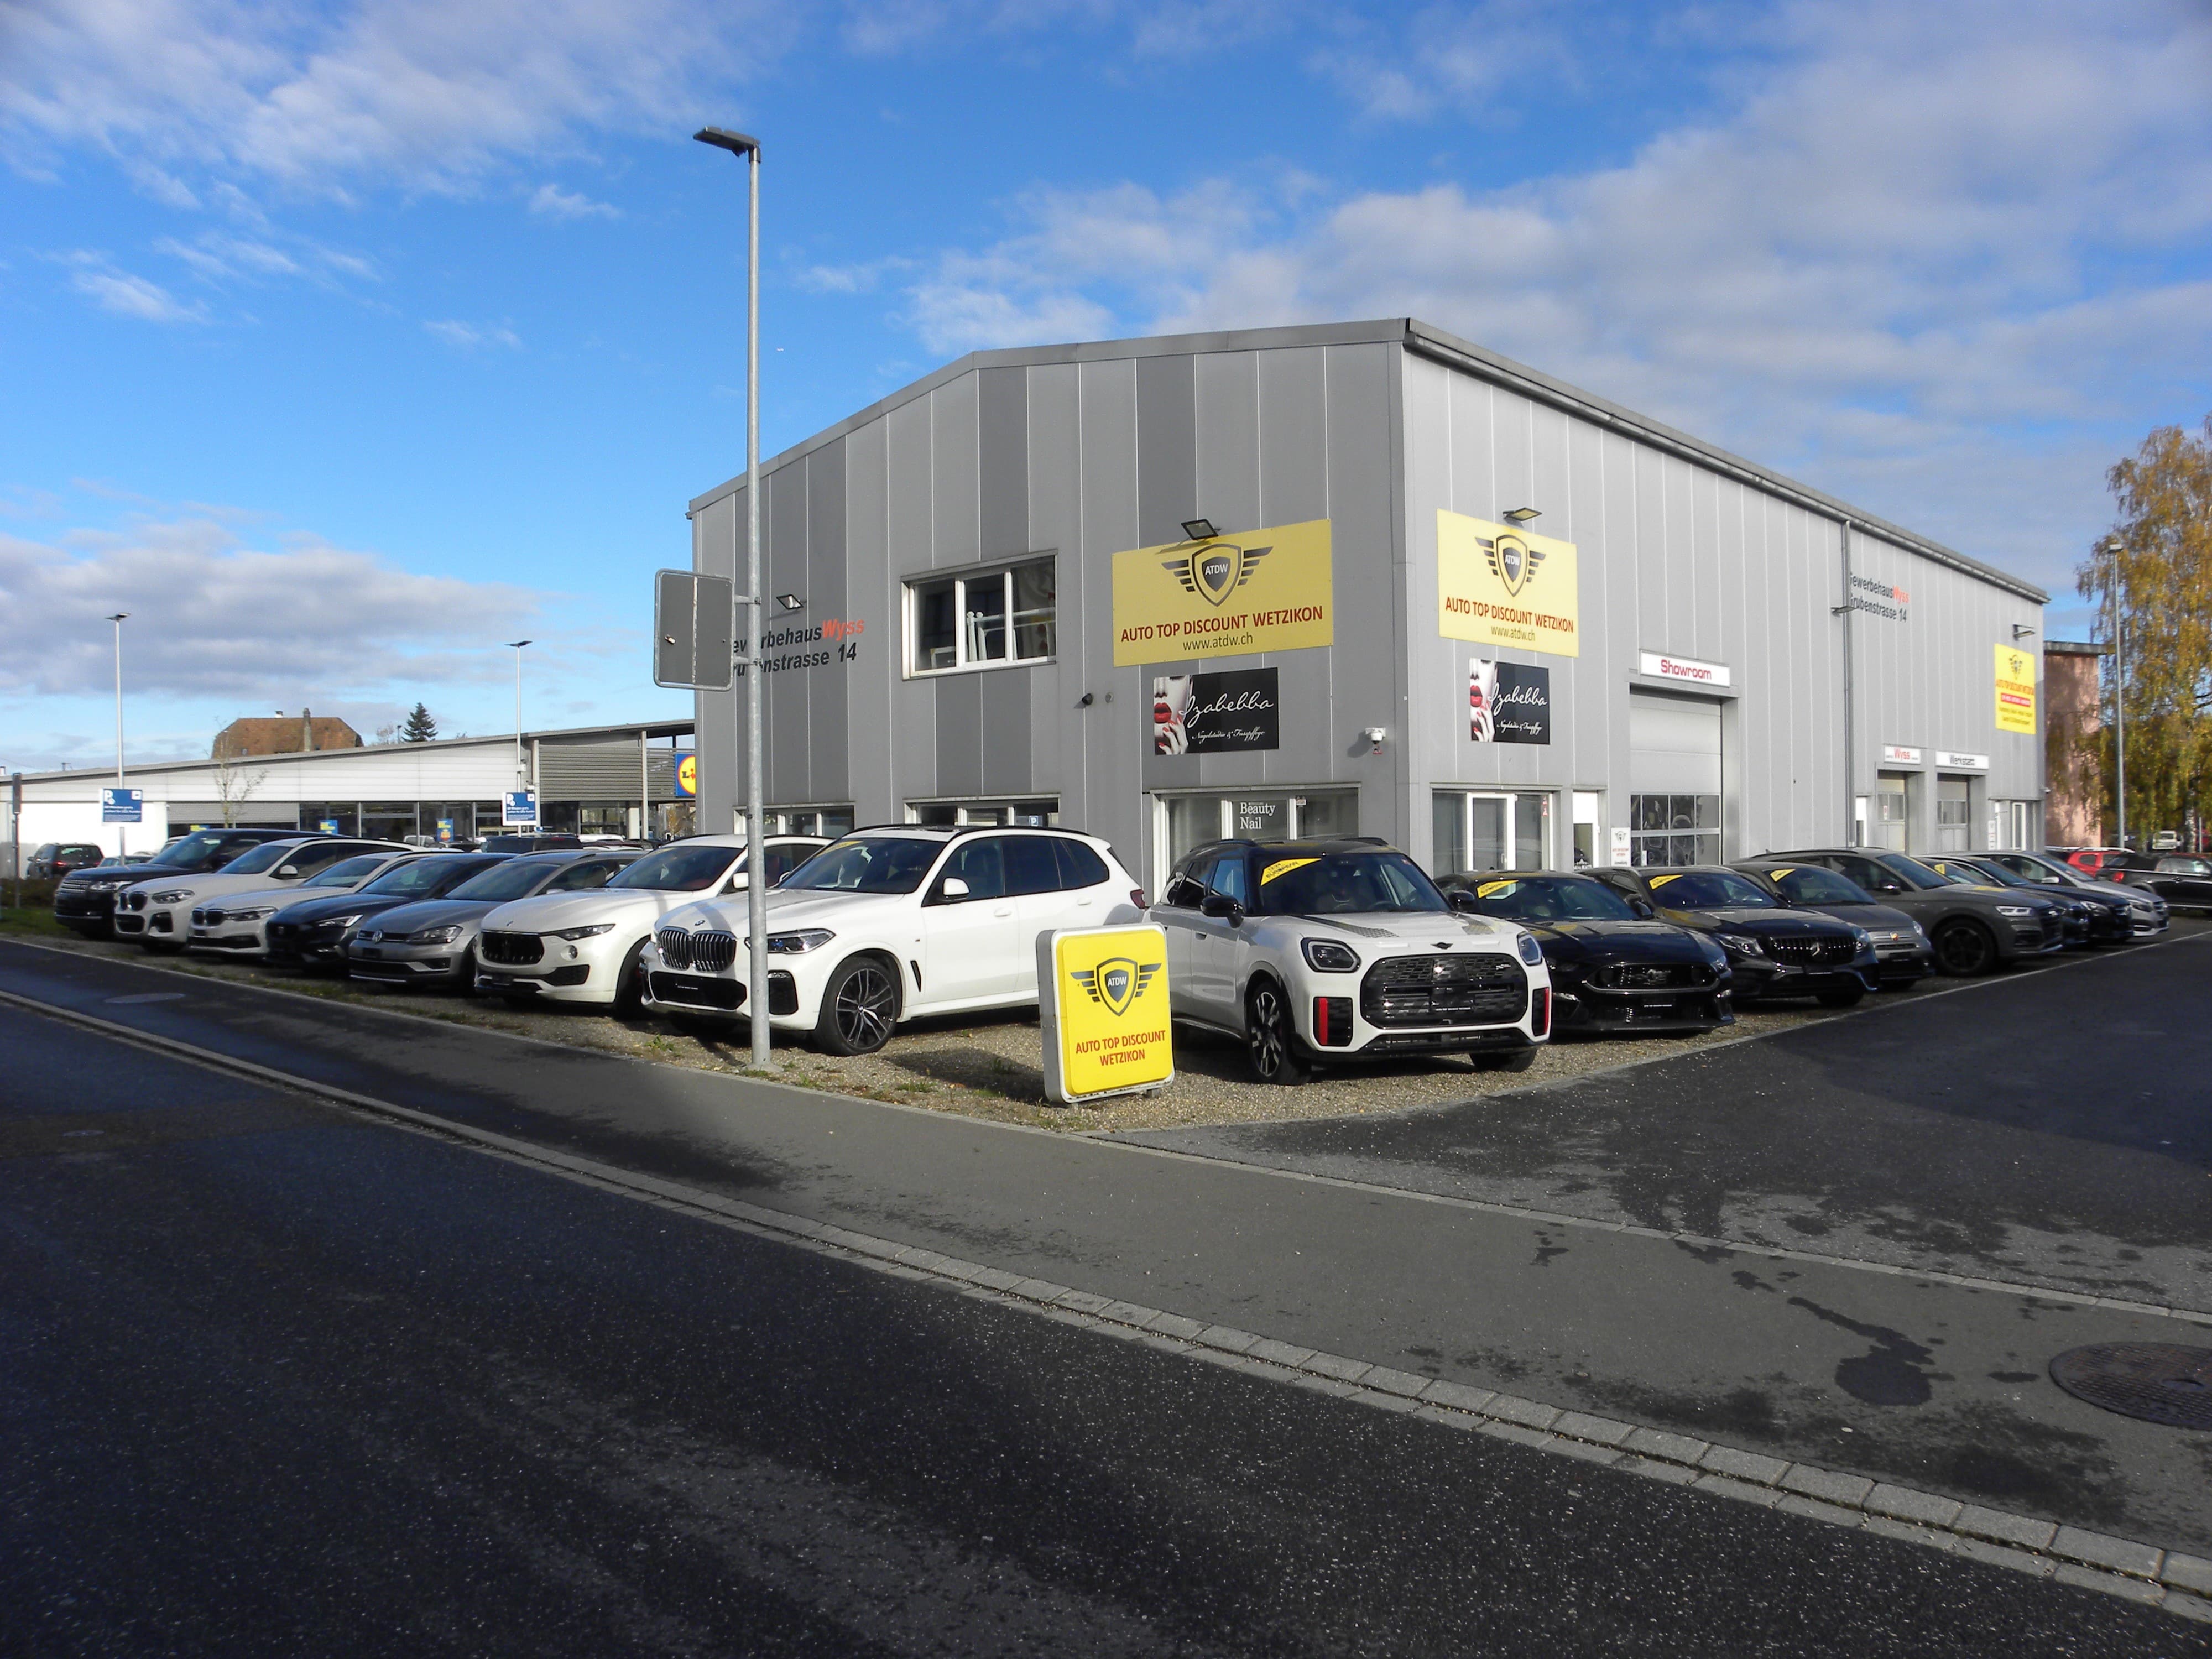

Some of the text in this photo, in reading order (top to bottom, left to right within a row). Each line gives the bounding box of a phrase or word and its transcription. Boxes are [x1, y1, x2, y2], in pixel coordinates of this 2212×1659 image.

[1505, 555, 1520, 566] ATDW
[1205, 564, 1228, 576] ATDW
[1446, 597, 1574, 633] AUTO TOP DISCOUNT WETZIKON
[1899, 608, 1907, 623] 14
[1121, 606, 1323, 642] AUTO TOP DISCOUNT WETZIKON
[1183, 632, 1253, 651] www.atdw.ch
[1490, 625, 1536, 641] www.atdw.ch
[733, 642, 857, 676] runstrasse 14
[1661, 659, 1712, 680] Showroom
[1240, 802, 1276, 816] Beauty
[1240, 817, 1262, 830] Nail
[1107, 975, 1127, 987] ATDW
[1076, 1030, 1166, 1055] AUTO TOP DISCOUNT
[1099, 1049, 1145, 1067] WETZIKON
